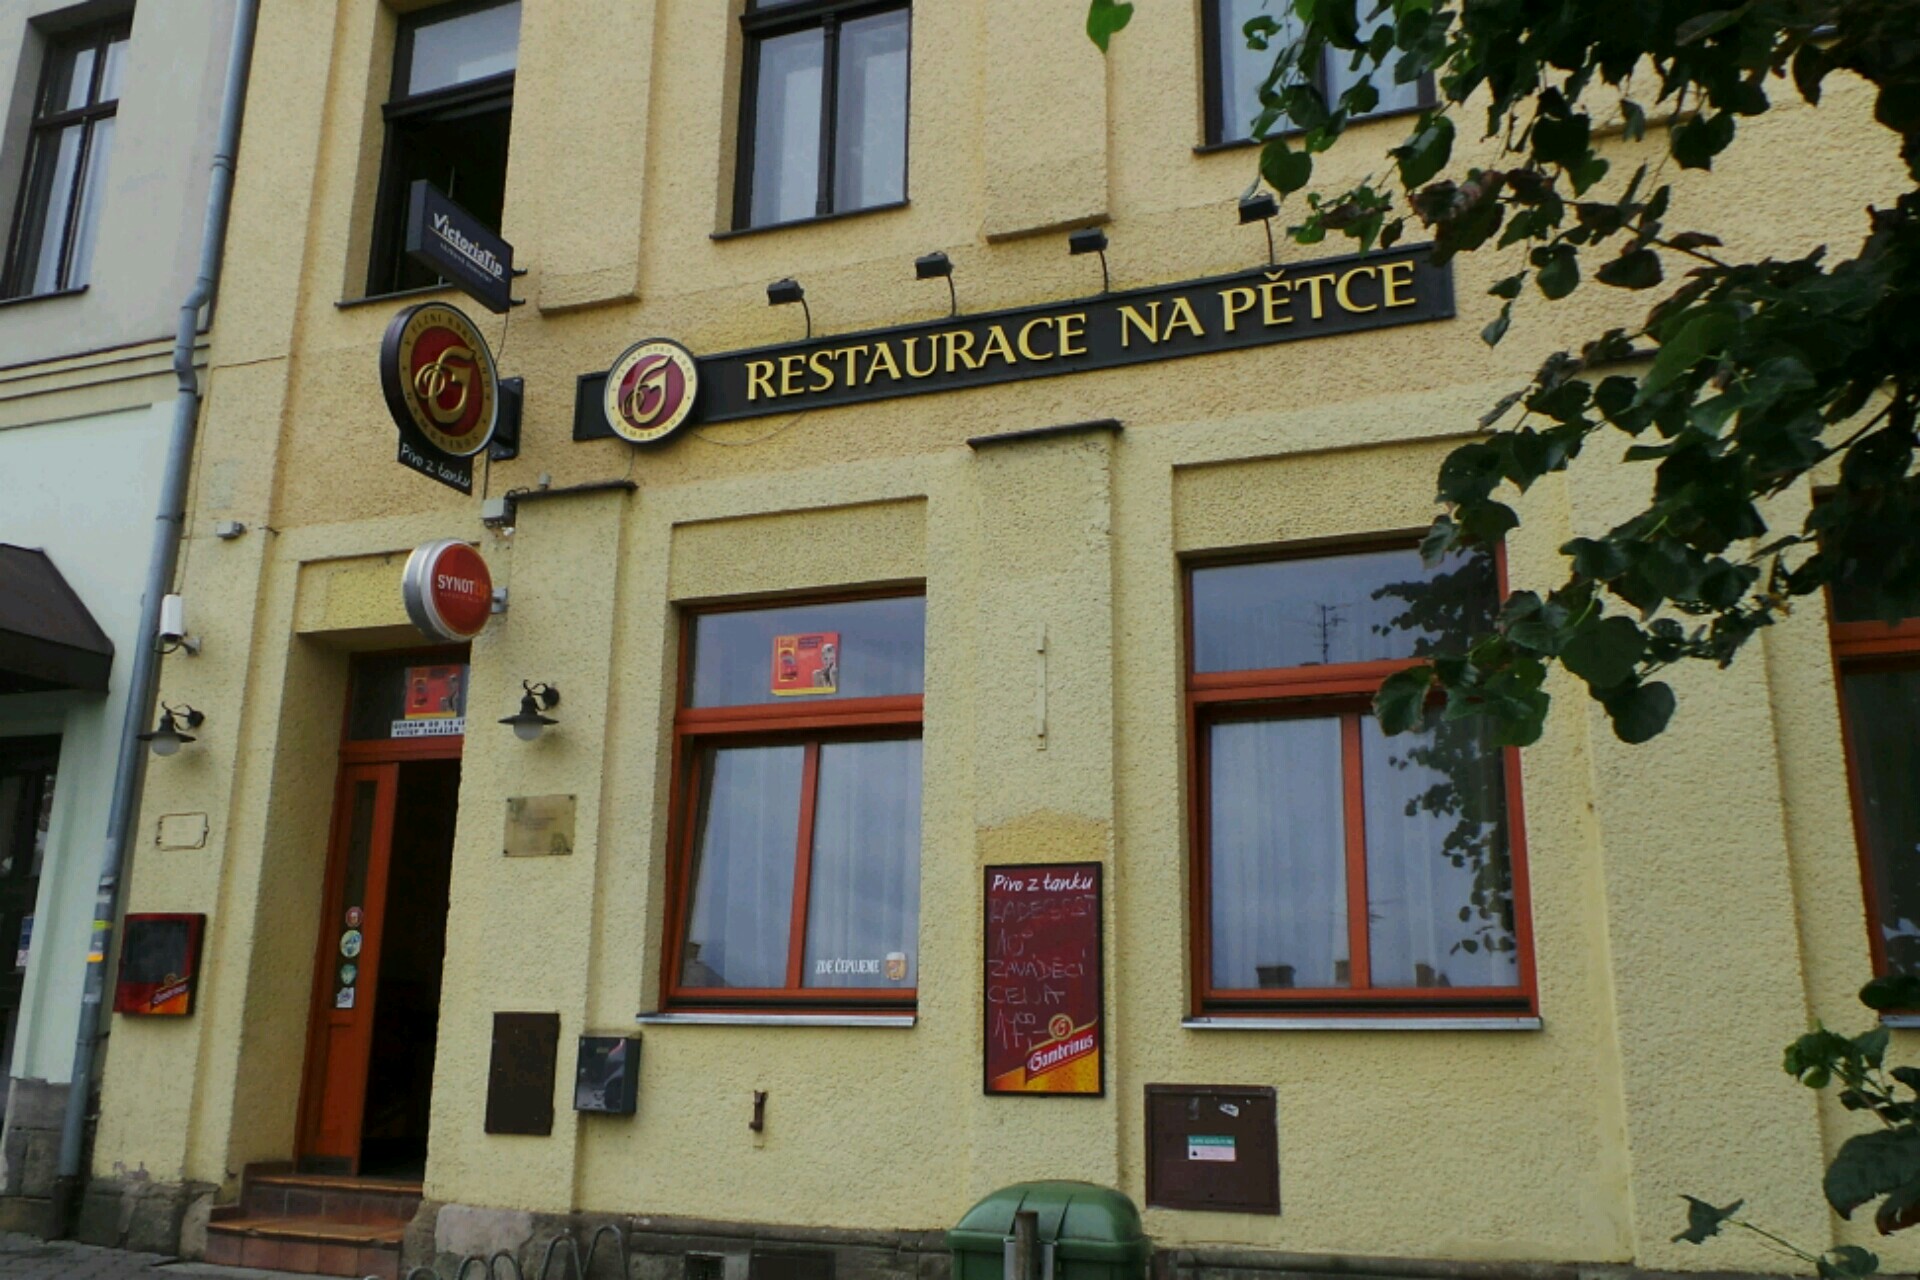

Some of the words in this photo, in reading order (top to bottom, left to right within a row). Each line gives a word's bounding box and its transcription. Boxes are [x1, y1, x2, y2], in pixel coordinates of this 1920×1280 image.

[433, 212, 503, 277] VictoriaTip
[744, 312, 1088, 400] RESTAURACE
[1116, 297, 1205, 347] NA
[1217, 260, 1417, 332] PĚTCE
[401, 442, 424, 467] Pivo
[437, 461, 471, 488] tanku
[437, 573, 475, 595] SYNOT
[992, 874, 1024, 892] Pivo
[1026, 878, 1040, 892] z
[1042, 871, 1093, 892] tanku
[1028, 1034, 1093, 1072] Gambrinus
